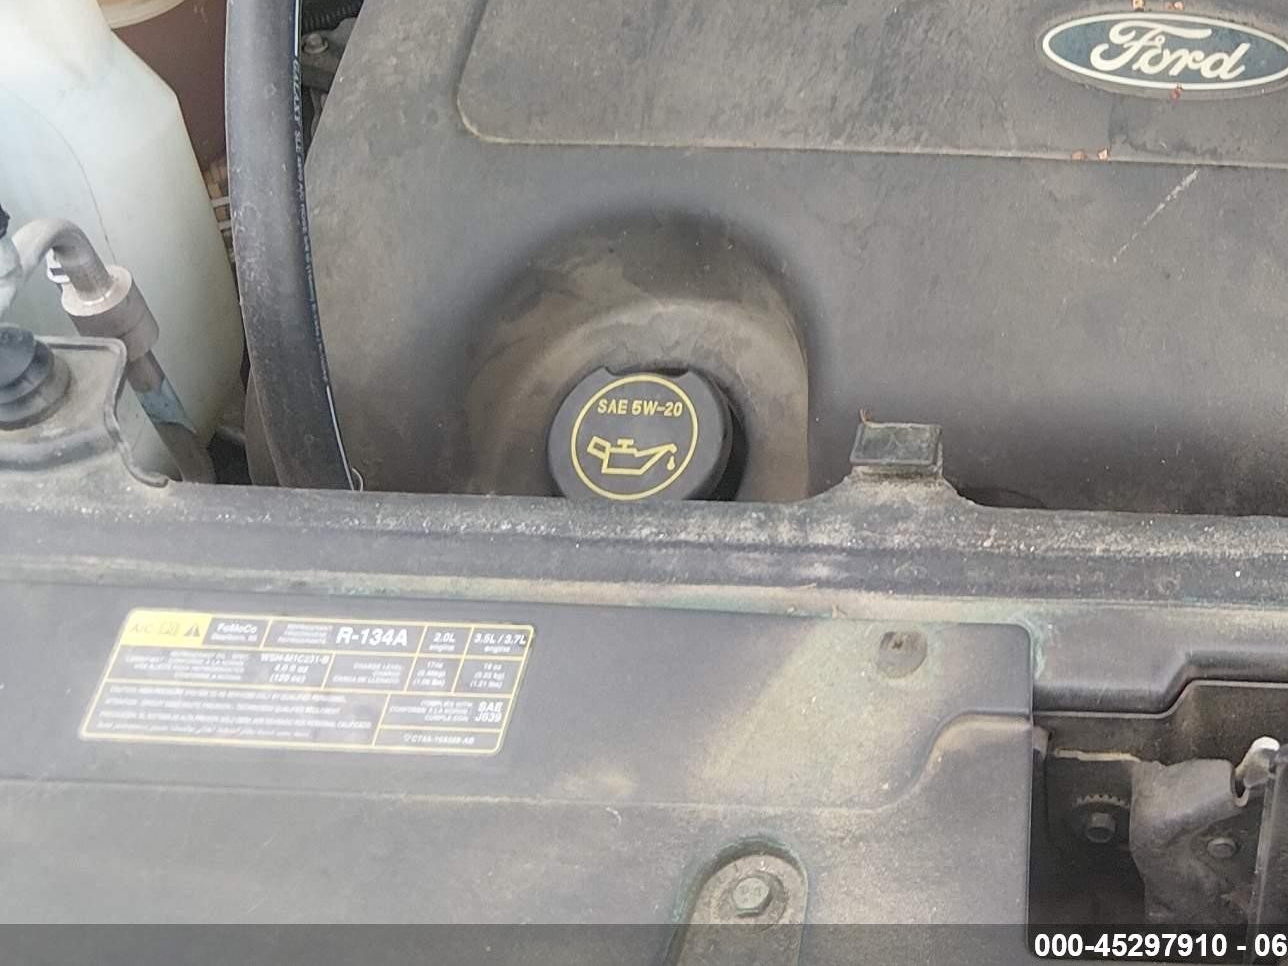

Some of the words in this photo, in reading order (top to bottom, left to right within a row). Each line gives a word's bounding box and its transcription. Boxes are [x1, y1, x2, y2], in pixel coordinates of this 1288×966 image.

[1090, 20, 1251, 80] Ford
[597, 399, 629, 415] SAE
[631, 400, 683, 416] 5W-20
[216, 622, 258, 634] FoMoCo
[336, 627, 408, 646] R-134A
[433, 633, 456, 643] 2.0L
[474, 634, 497, 644] 3.5L
[504, 634, 526, 645] 3.7L
[478, 701, 503, 712] SAE
